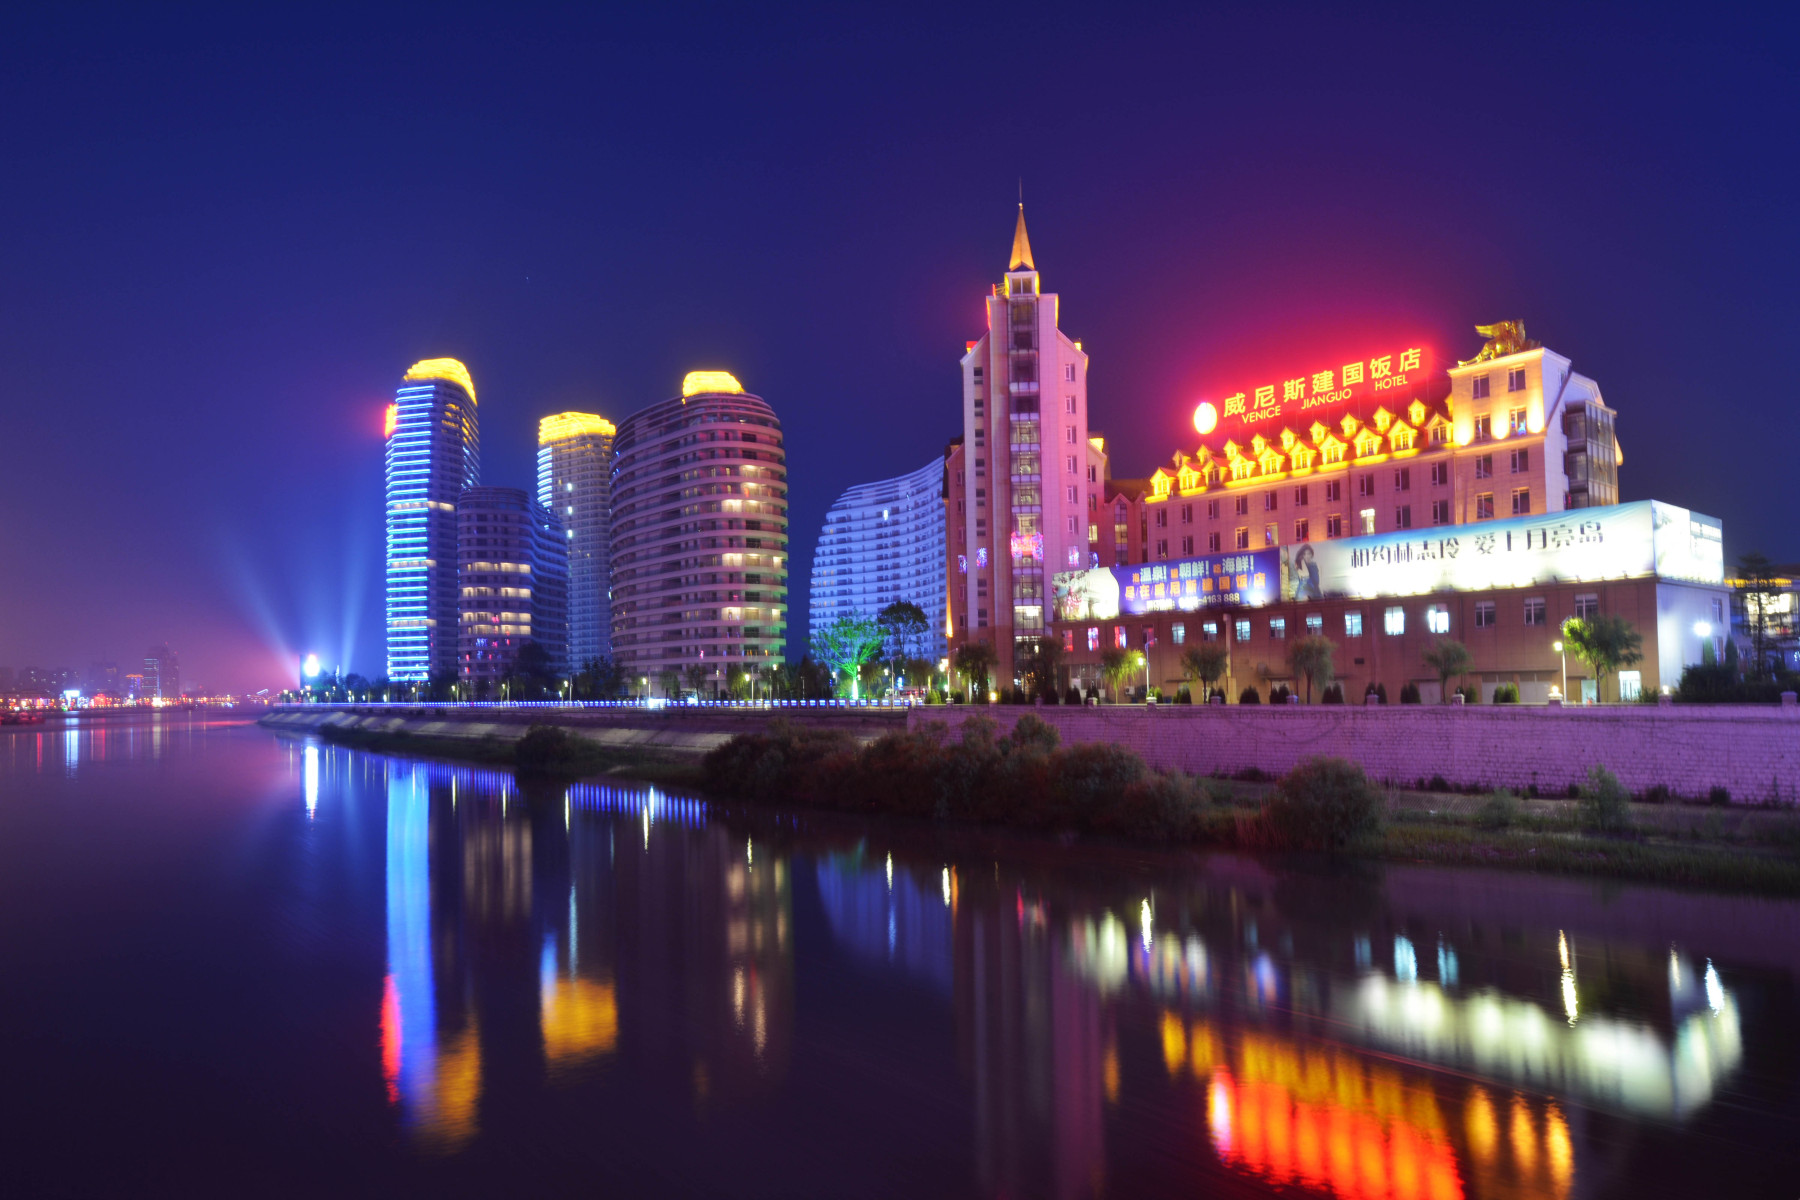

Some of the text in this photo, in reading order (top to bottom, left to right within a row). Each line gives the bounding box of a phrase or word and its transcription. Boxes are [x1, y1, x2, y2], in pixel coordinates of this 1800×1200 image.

[1223, 348, 1421, 417] 威尼斯建国饭店
[1241, 374, 1408, 424] VENICE JIANGUO HOTEL
